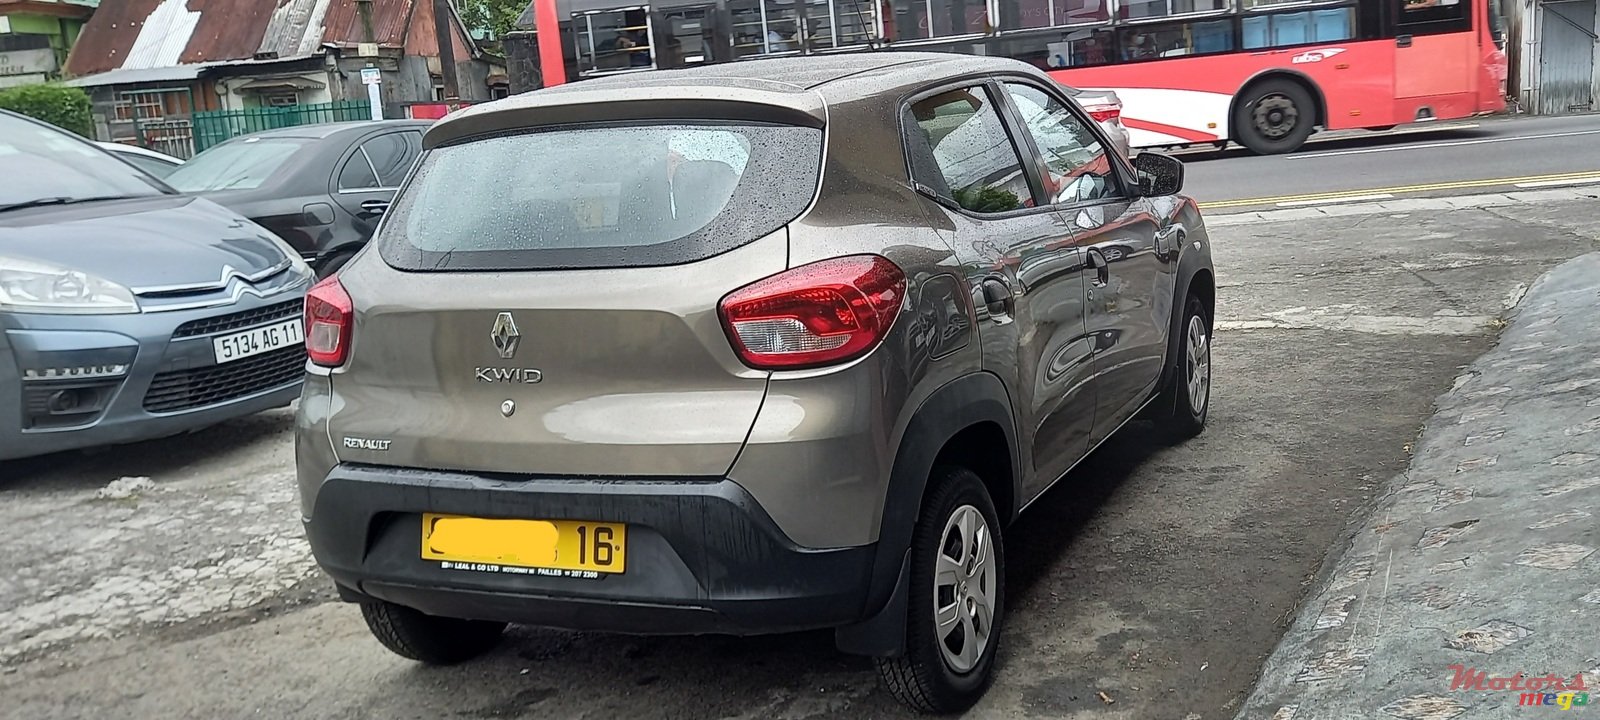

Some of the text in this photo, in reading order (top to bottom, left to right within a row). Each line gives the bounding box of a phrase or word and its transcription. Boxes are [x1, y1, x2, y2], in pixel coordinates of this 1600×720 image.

[222, 323, 297, 358] 5134 AG 11
[475, 367, 543, 383] KWID
[343, 437, 392, 450] RENAULT
[577, 526, 614, 566] 16
[454, 562, 470, 570] LEAL
[537, 568, 562, 576] PAILLES
[571, 570, 582, 578] 207
